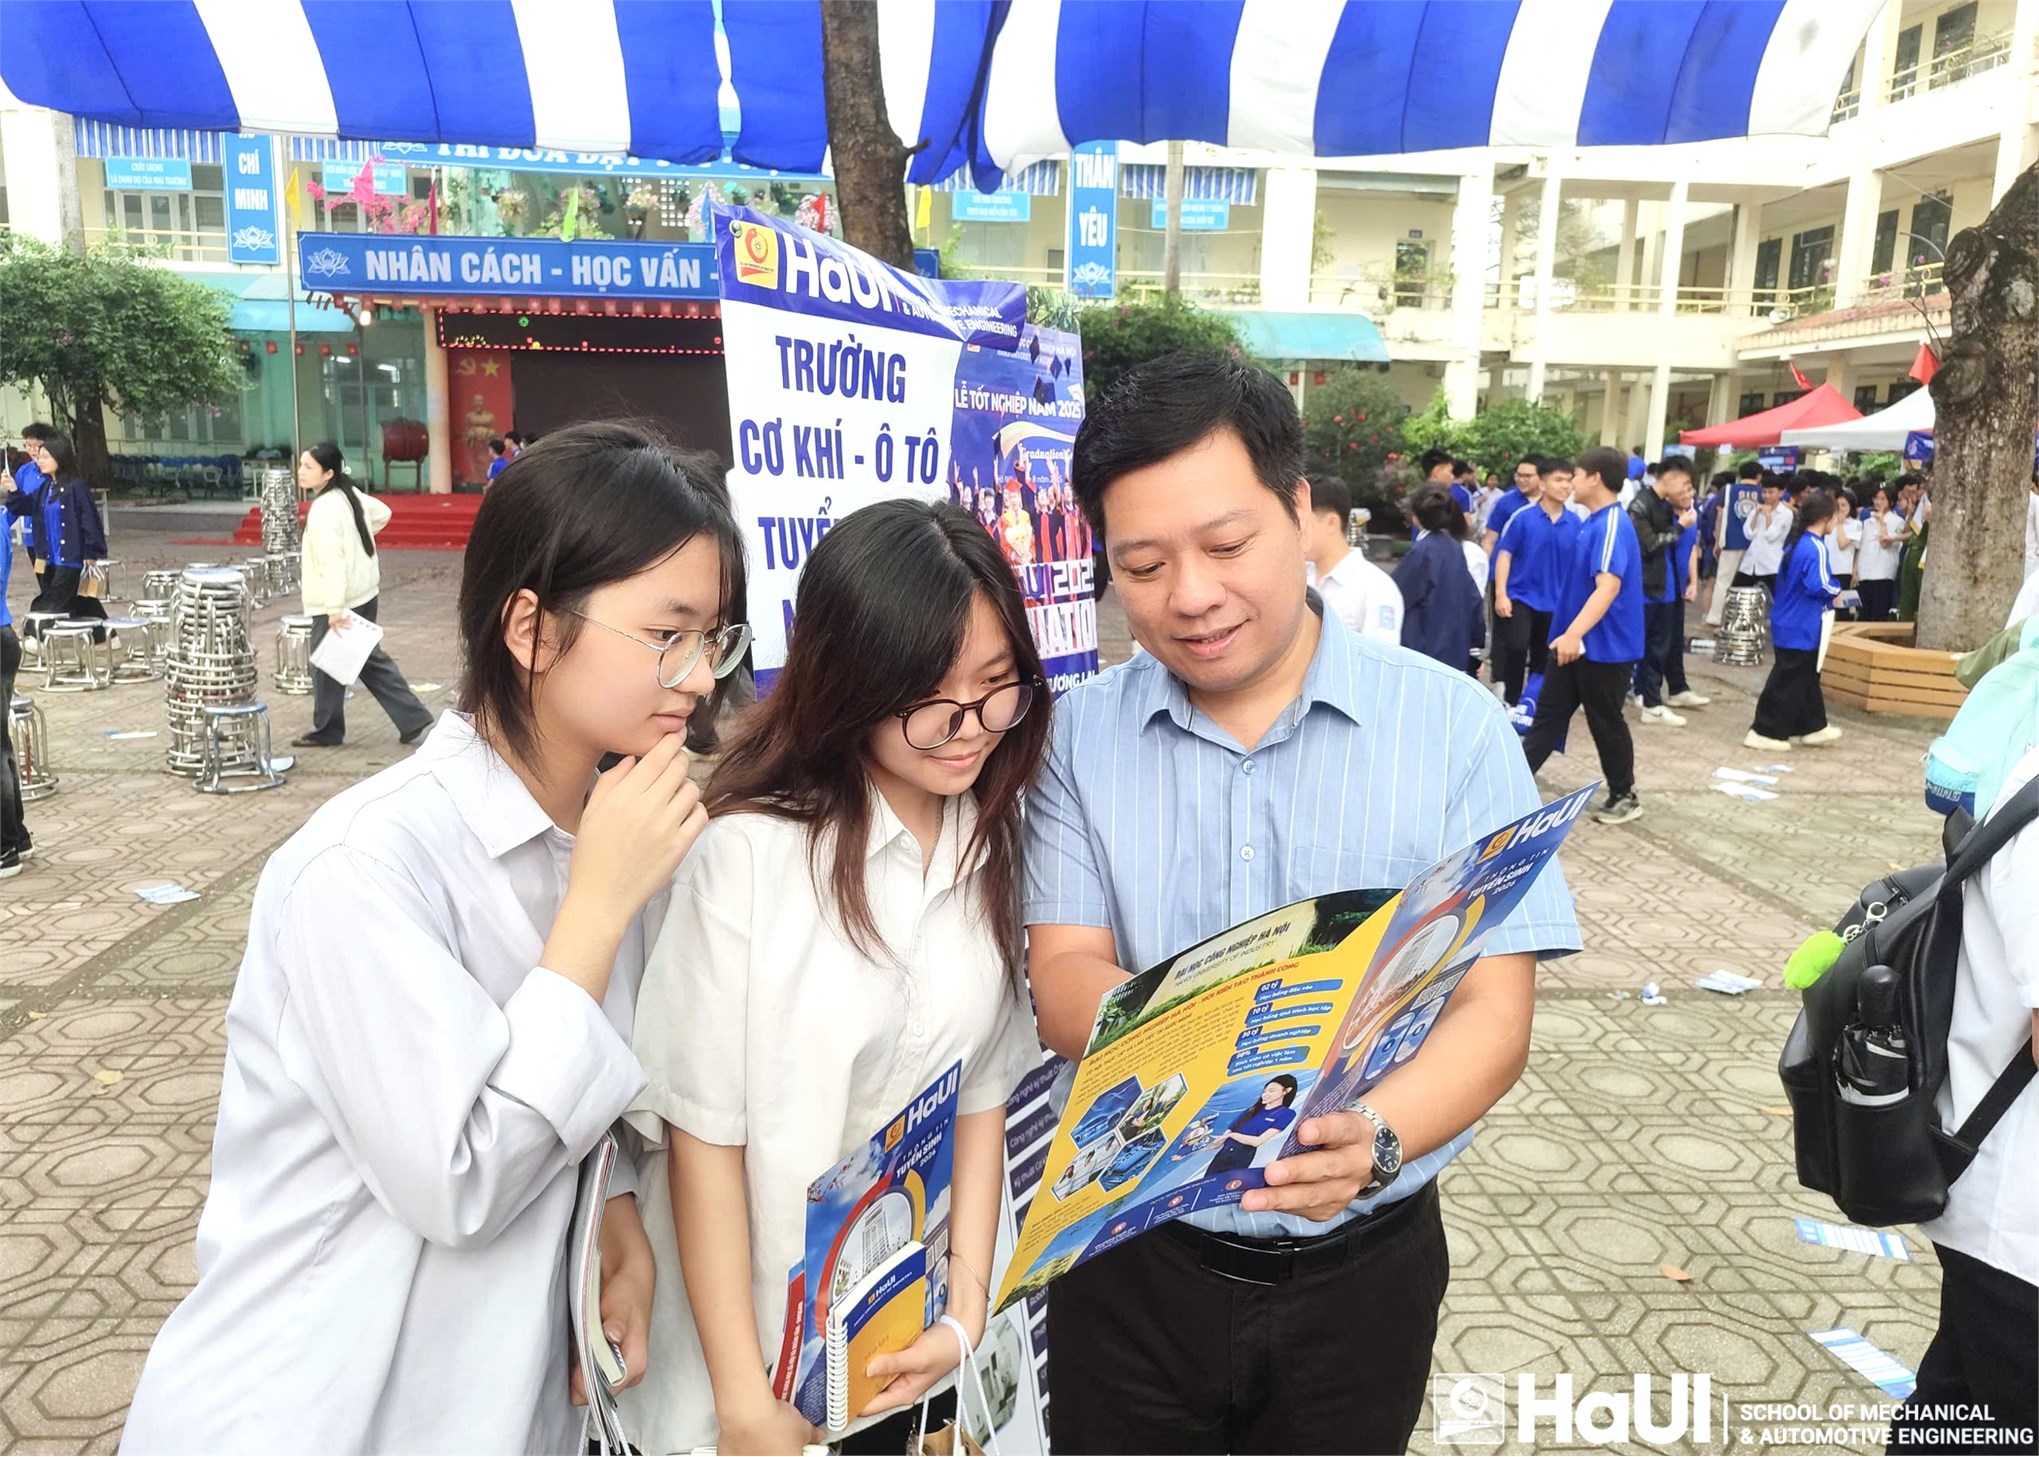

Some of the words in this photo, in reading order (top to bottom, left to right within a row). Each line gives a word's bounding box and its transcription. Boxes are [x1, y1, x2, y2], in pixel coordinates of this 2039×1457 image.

[238, 149, 260, 175] CHÍ
[1075, 147, 1114, 188] THÂN
[234, 189, 268, 211] MINH
[1079, 206, 1107, 247] YÊU
[365, 244, 451, 284] NHÂN
[461, 246, 541, 285] CÁCH
[572, 256, 632, 292] HỌC
[640, 247, 701, 288] VẤN
[967, 320, 1018, 337] ENGINEERING
[775, 333, 906, 403] TRƯỜNG
[954, 381, 968, 409] LỄ
[969, 384, 990, 411] TỐT
[991, 390, 1027, 418] NGHIỆP
[1058, 400, 1082, 419] 2025
[739, 419, 786, 476] CƠ
[793, 418, 845, 480] KHÍ
[875, 423, 894, 483] Ô
[905, 427, 939, 484] TÔ
[1507, 788, 1593, 850] HaUI
[1505, 862, 1534, 883] SINH
[907, 1067, 958, 1134] HaUI
[896, 1150, 923, 1178] TUYỂN
[923, 1132, 942, 1155] SINH
[876, 1275, 896, 1297] HaUI
